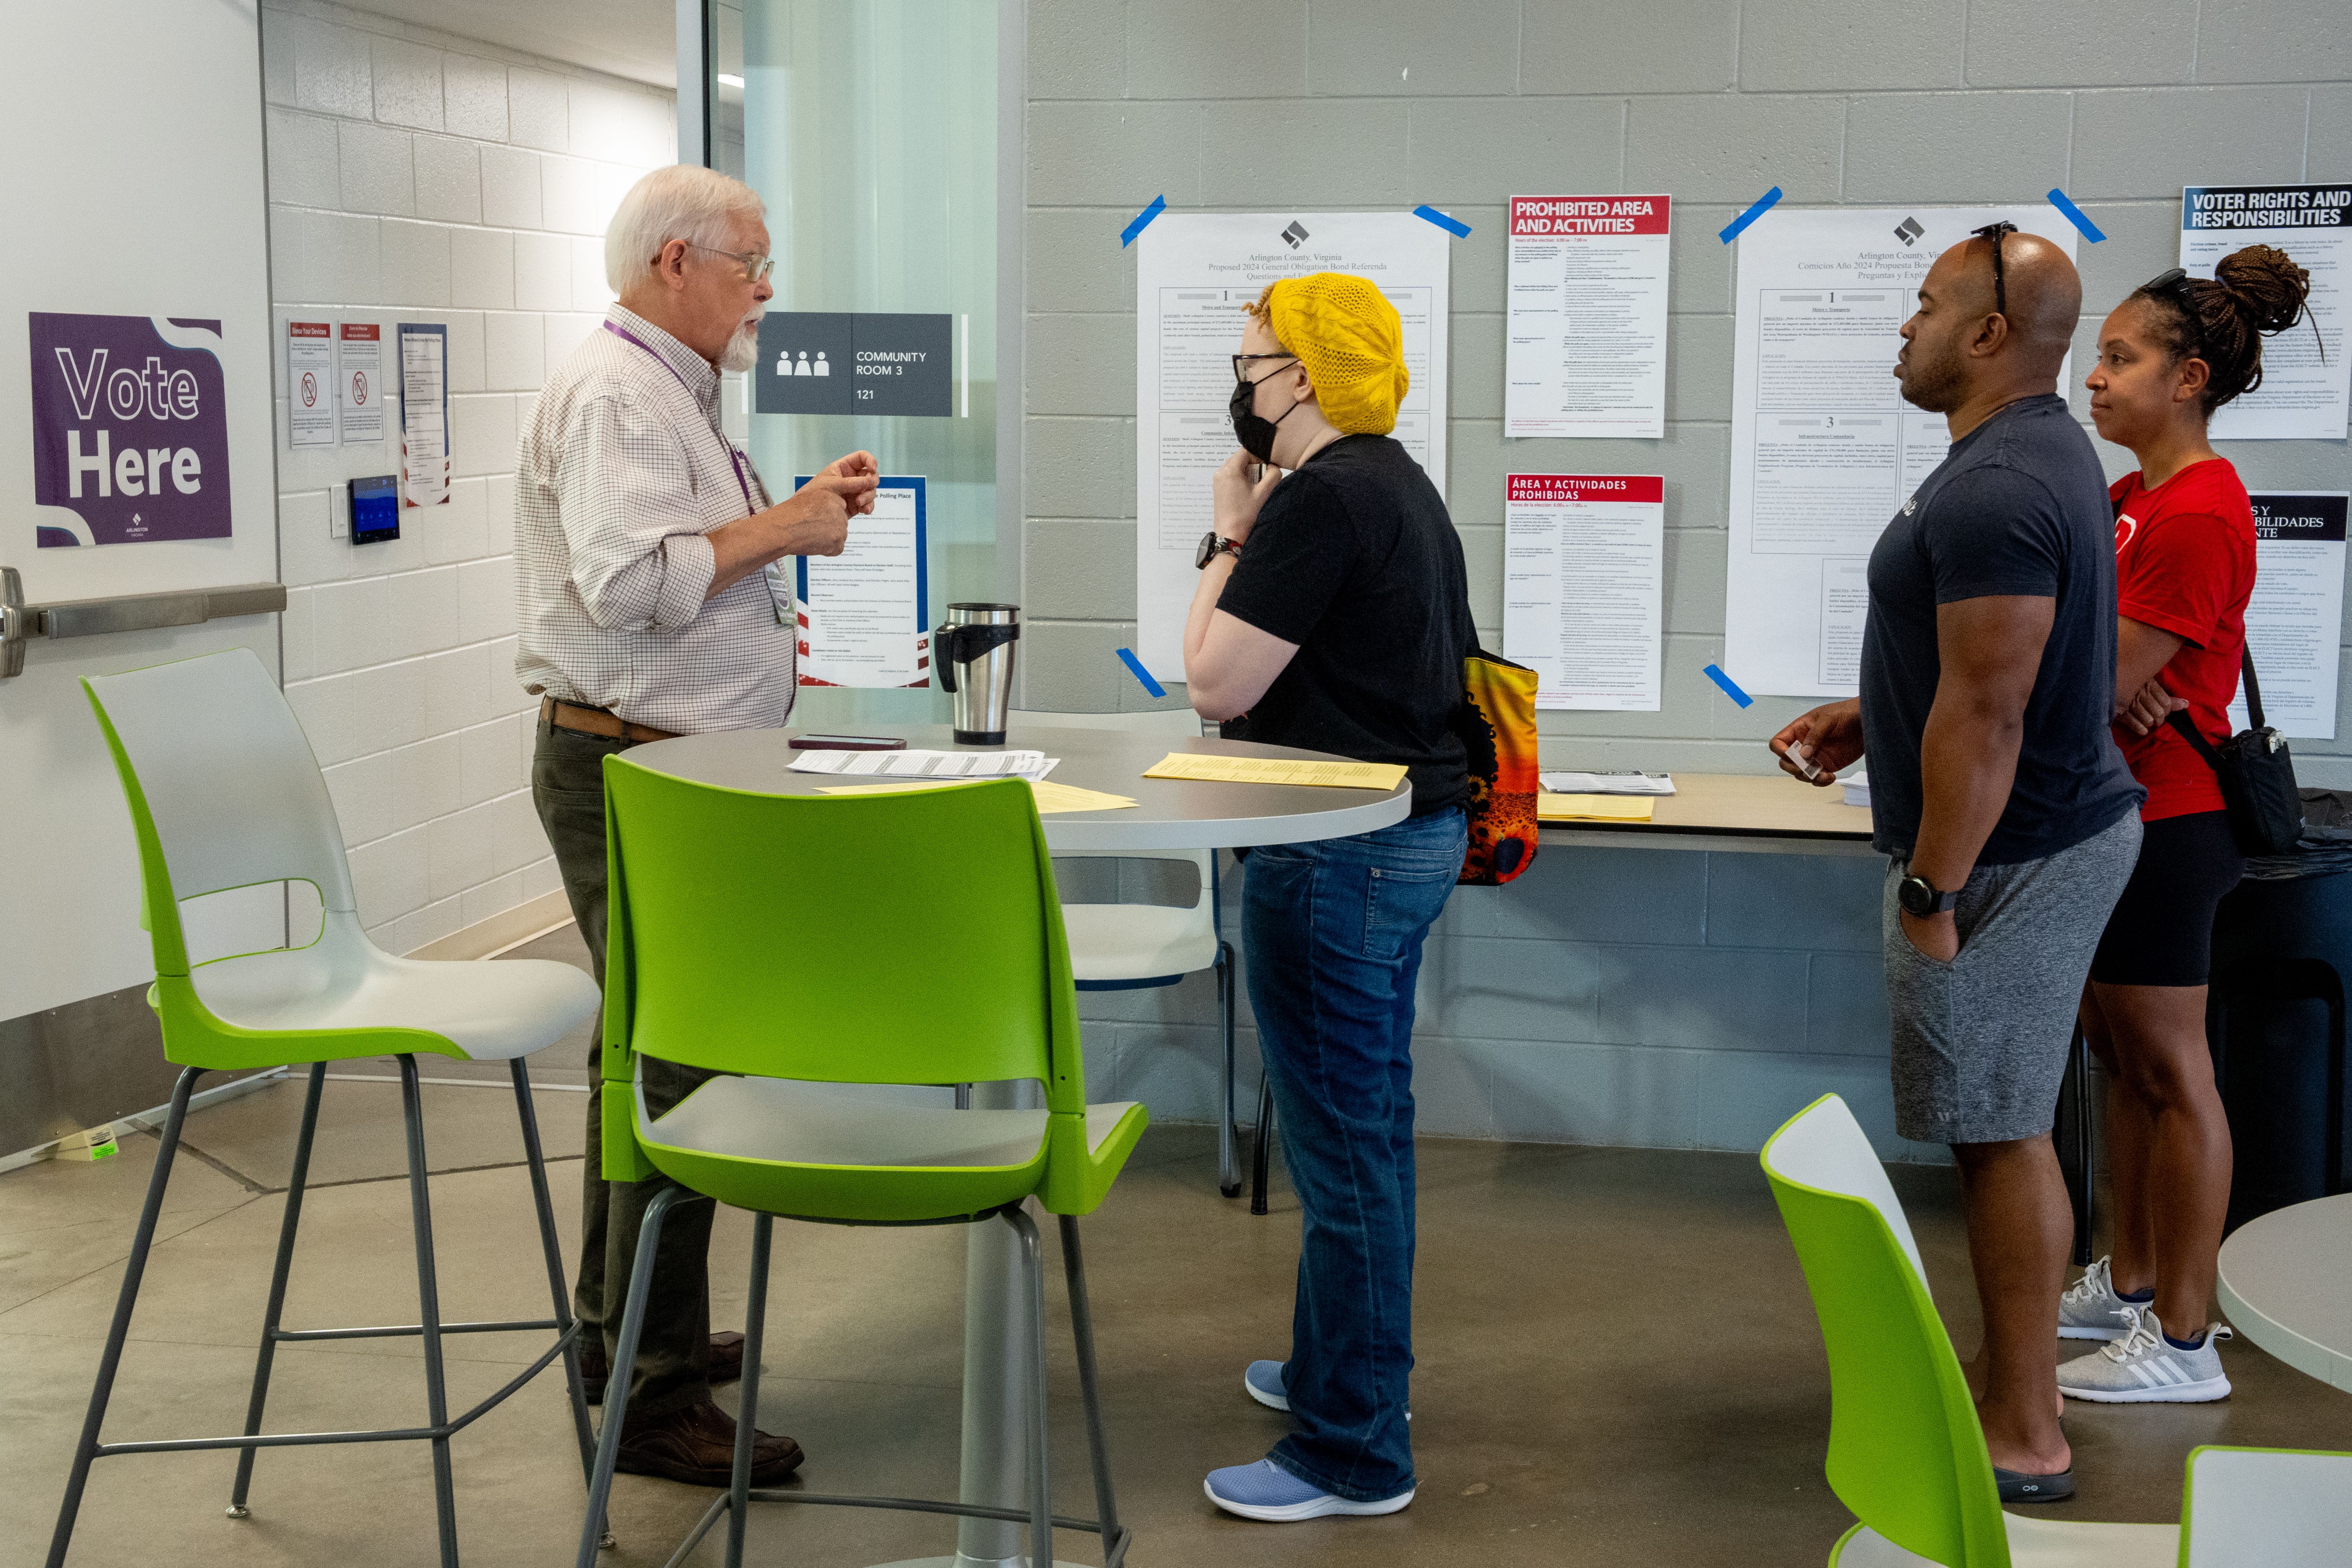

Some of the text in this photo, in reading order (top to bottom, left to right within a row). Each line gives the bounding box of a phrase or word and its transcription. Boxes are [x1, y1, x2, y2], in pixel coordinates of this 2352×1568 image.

[2193, 191, 2351, 210] VOTER RIGHTS AND
[1516, 201, 1653, 216] PROHIBITED AREA
[2192, 209, 2341, 227] RESPONSIBILITIES
[1515, 218, 1635, 233] AND ACTIVITIES
[1249, 254, 1282, 263] Arlington
[1313, 254, 1342, 263] Virginia
[1858, 252, 1894, 261] Arlington
[1208, 264, 1240, 273] Proposed
[1291, 263, 1328, 272] Obligation
[1874, 262, 1911, 271] Propuesta
[1858, 272, 1895, 280] Preguntas
[1223, 290, 1228, 301] 1
[1829, 292, 1834, 303] 1
[856, 352, 926, 362] COMMUNITY
[856, 366, 903, 375] ROOM 3
[55, 347, 198, 420] Vote
[857, 390, 874, 399] 121
[1225, 415, 1232, 426] 3
[1827, 417, 1834, 428] 3
[68, 430, 201, 498] Here
[1512, 477, 1626, 490] ÁREA Y ACTIVIDADES
[1512, 490, 1578, 500] PROHIBIDAS
[2261, 506, 2270, 516] Y
[2254, 517, 2323, 527] BILIDADES
